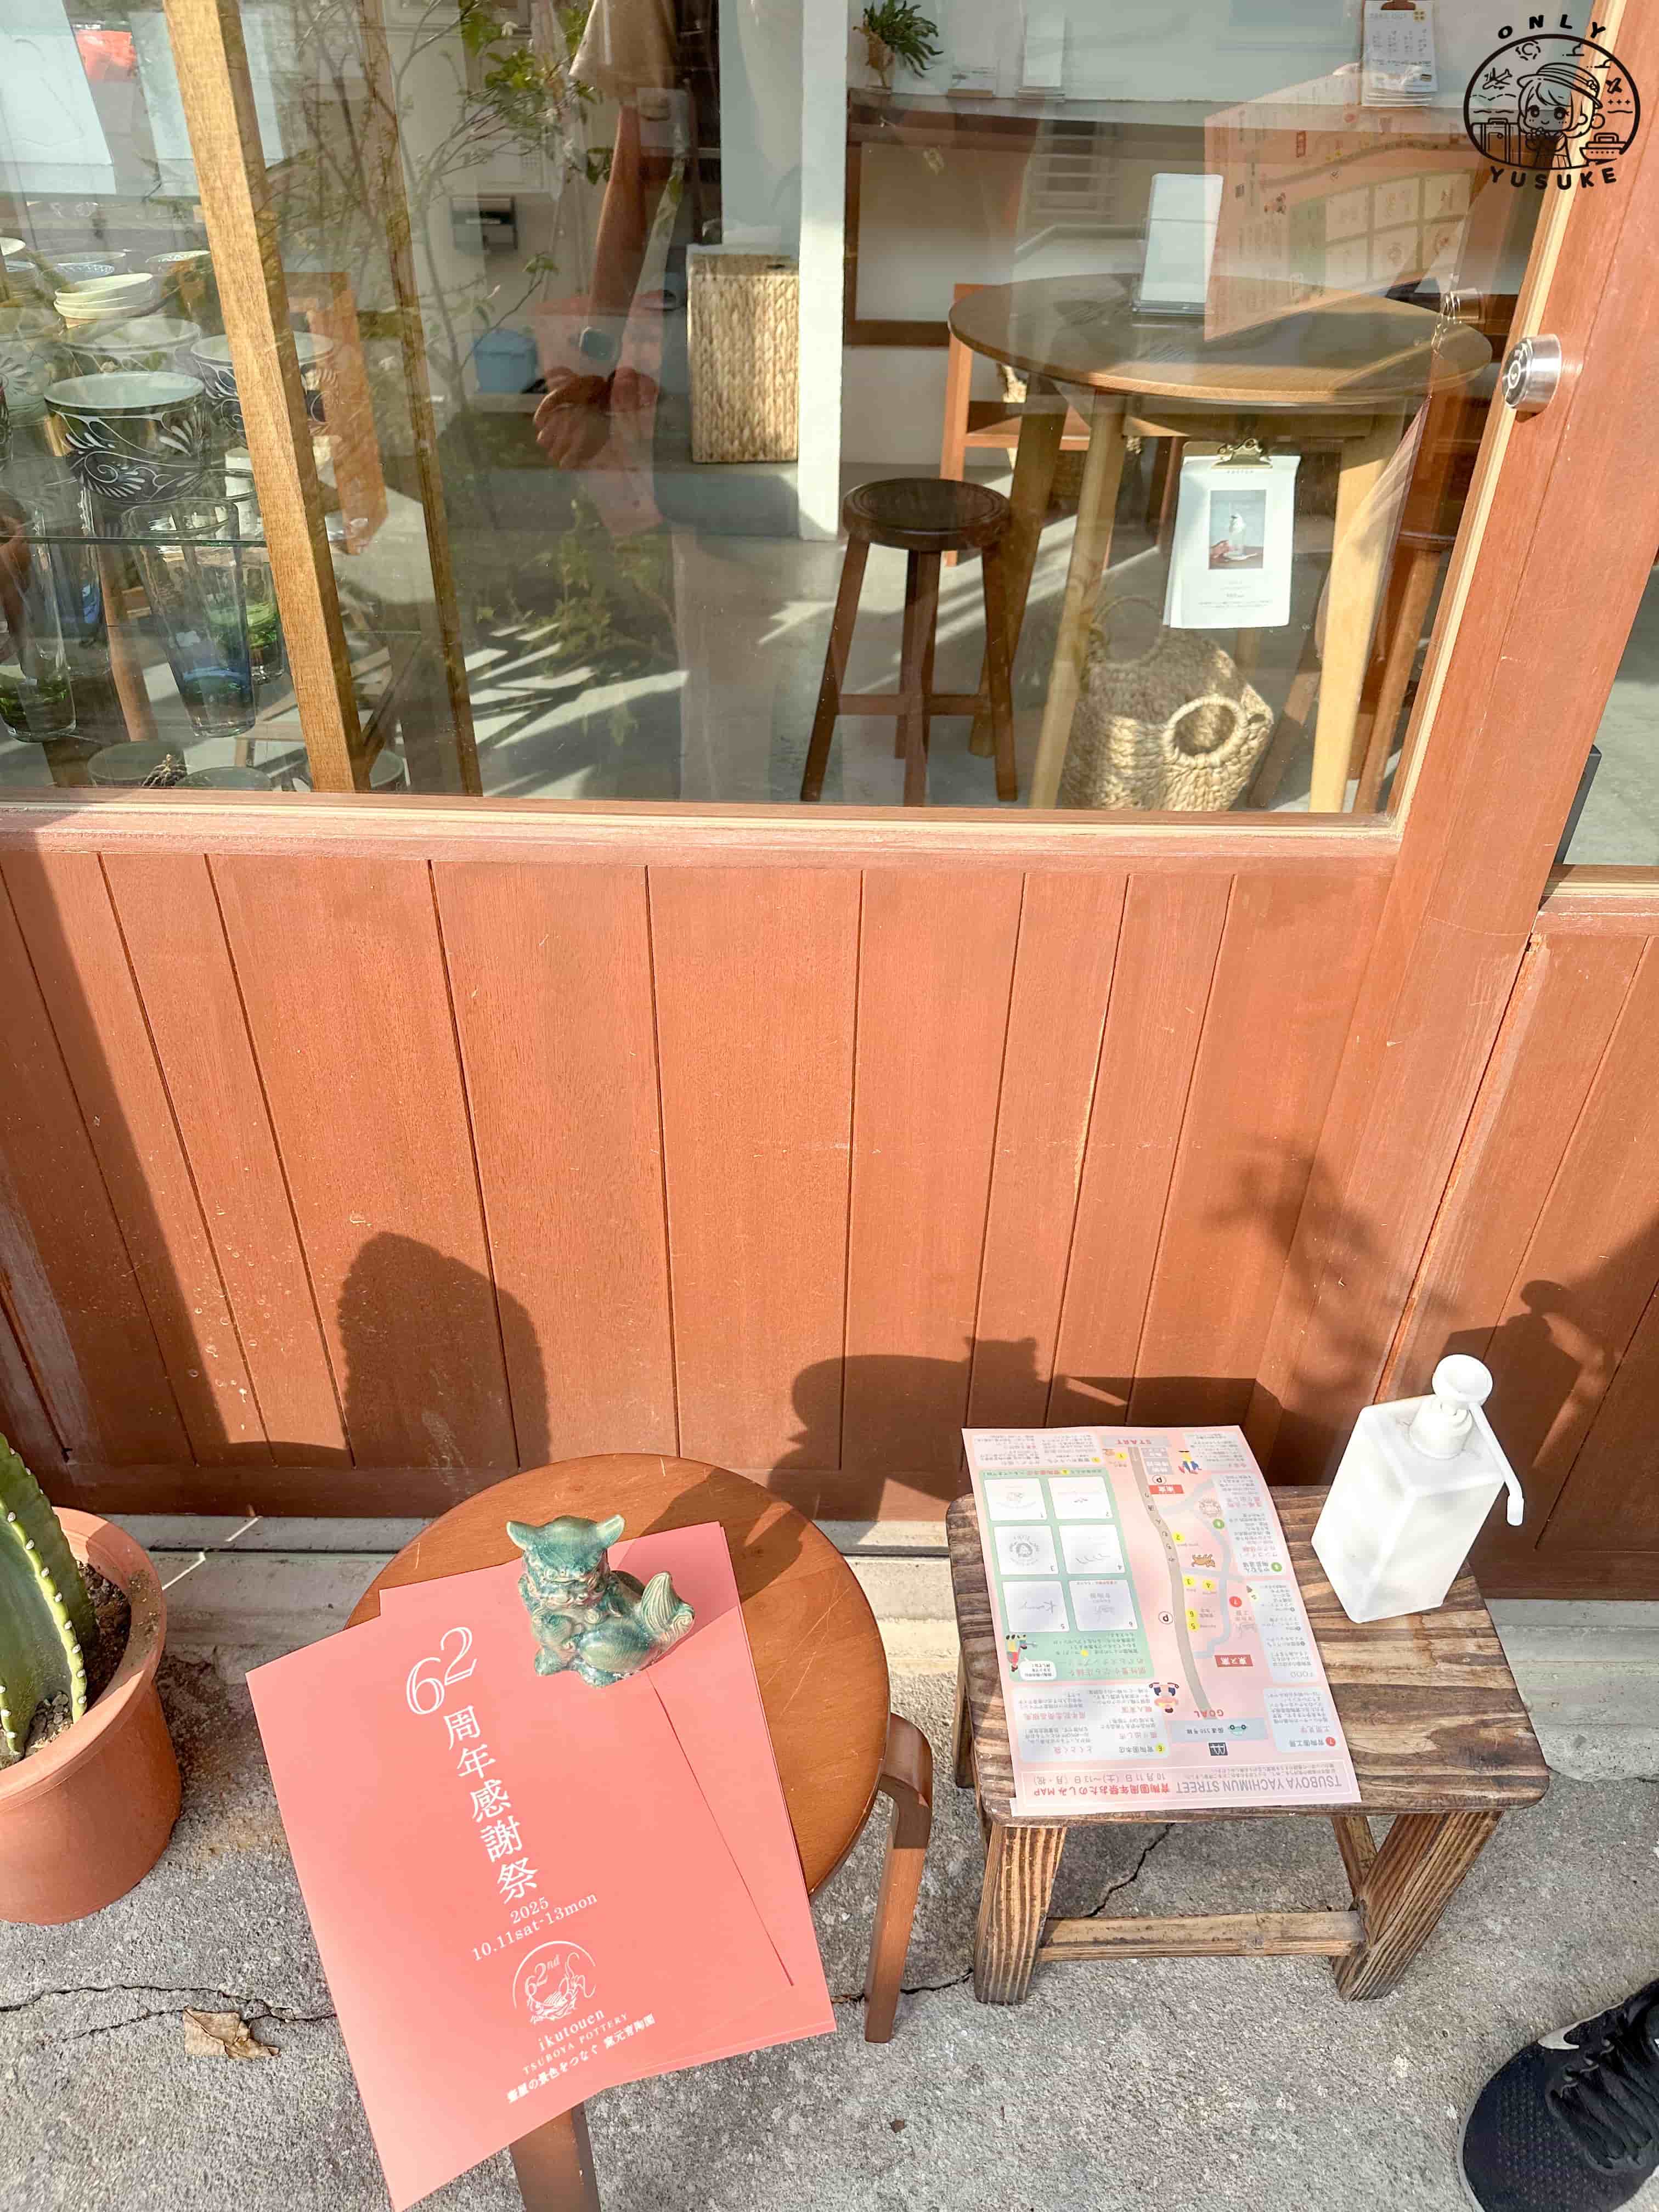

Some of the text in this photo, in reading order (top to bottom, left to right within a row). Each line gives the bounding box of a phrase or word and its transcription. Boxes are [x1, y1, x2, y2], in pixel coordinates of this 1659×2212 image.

[406, 1626, 477, 1715] 62
[1193, 1708, 1224, 1718] GOAL
[443, 1705, 539, 1904] 周年感謝祭
[1176, 1774, 1342, 1793] TSUBOYA YACHIMUN STREET
[471, 1893, 598, 1962] 10.11sat-13mon
[510, 1897, 549, 1925] 2025
[522, 2013, 629, 2076] TSUBOYA POTTERY
[538, 2009, 605, 2052] ikutouen
